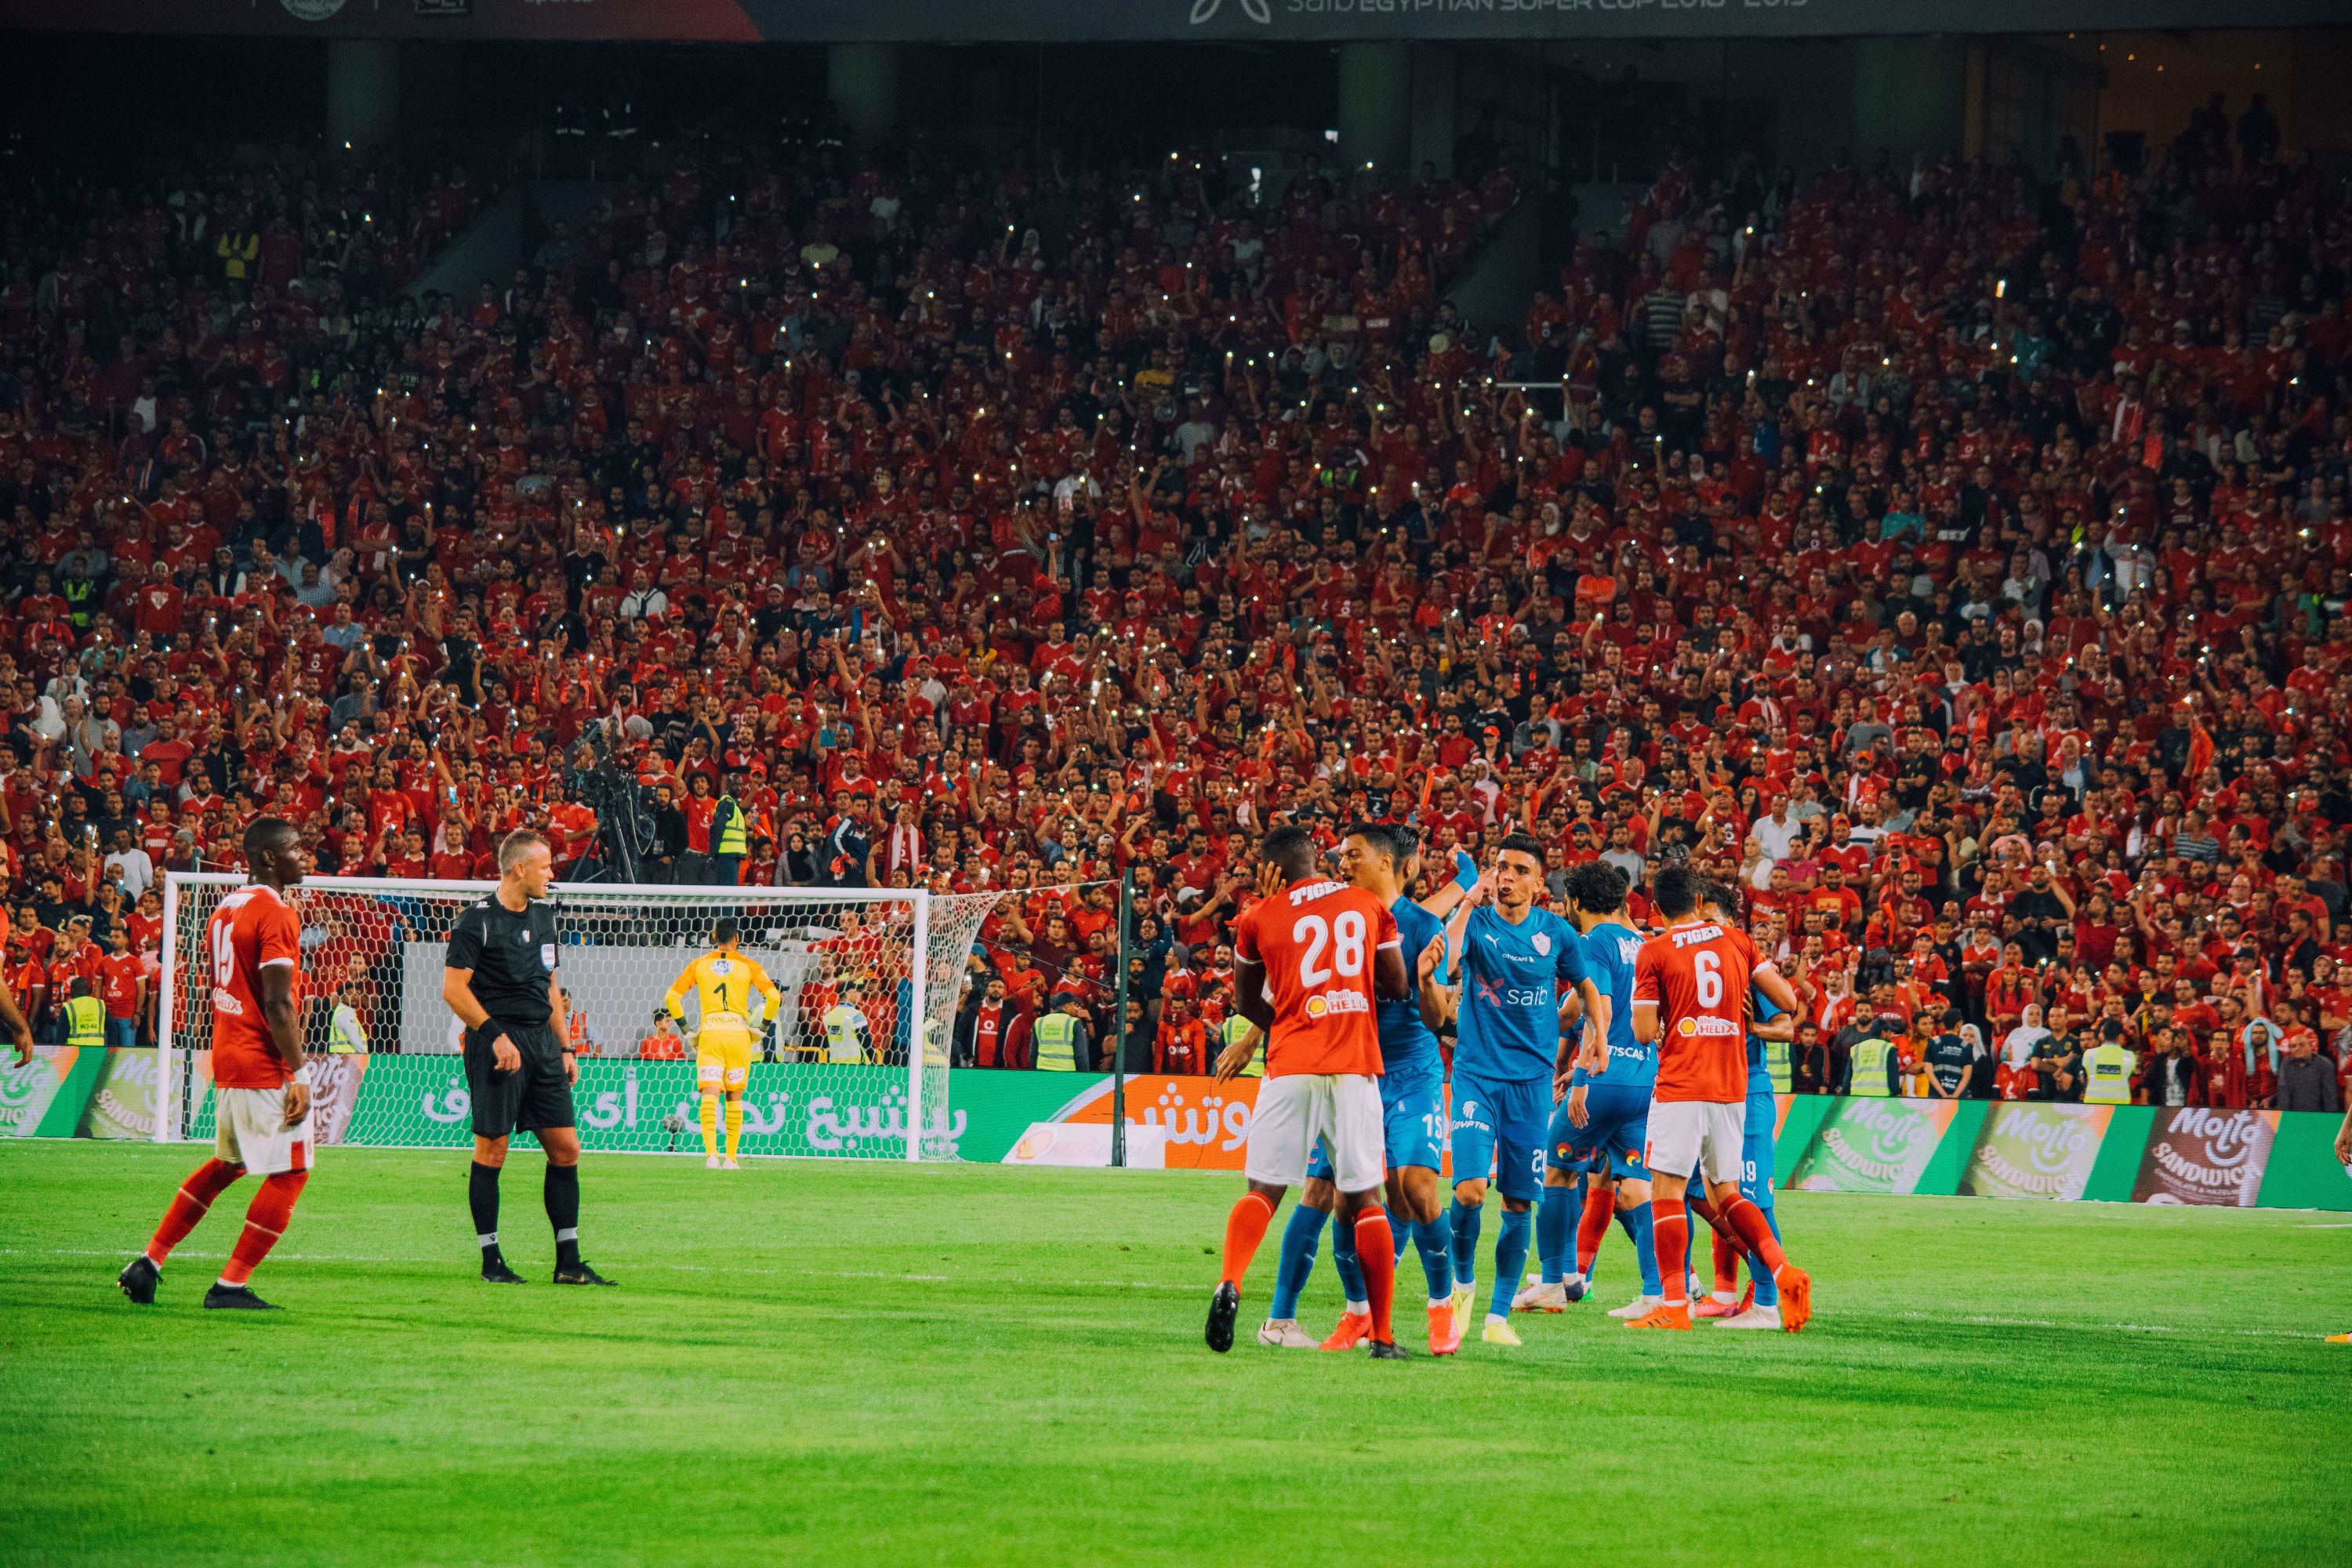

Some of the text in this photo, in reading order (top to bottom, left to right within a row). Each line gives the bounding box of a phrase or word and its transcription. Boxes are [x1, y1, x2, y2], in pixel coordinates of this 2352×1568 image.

[1293, 910, 1366, 988] 28
[1671, 925, 1725, 949] TIGER
[713, 982, 728, 1011] 1
[1506, 985, 1548, 1006] saib
[1694, 950, 1723, 1009] 6
[1700, 1024, 1737, 1034] HELIX
[304, 1054, 350, 1092] olto
[1842, 1098, 1926, 1147] Molto
[1995, 1108, 2086, 1159] Molto
[2167, 1107, 2260, 1152] Molto
[1823, 1128, 1904, 1181] SANDWIC
[1977, 1145, 2067, 1192] SANDWIC
[2152, 1142, 2245, 1187] SANDWIC
